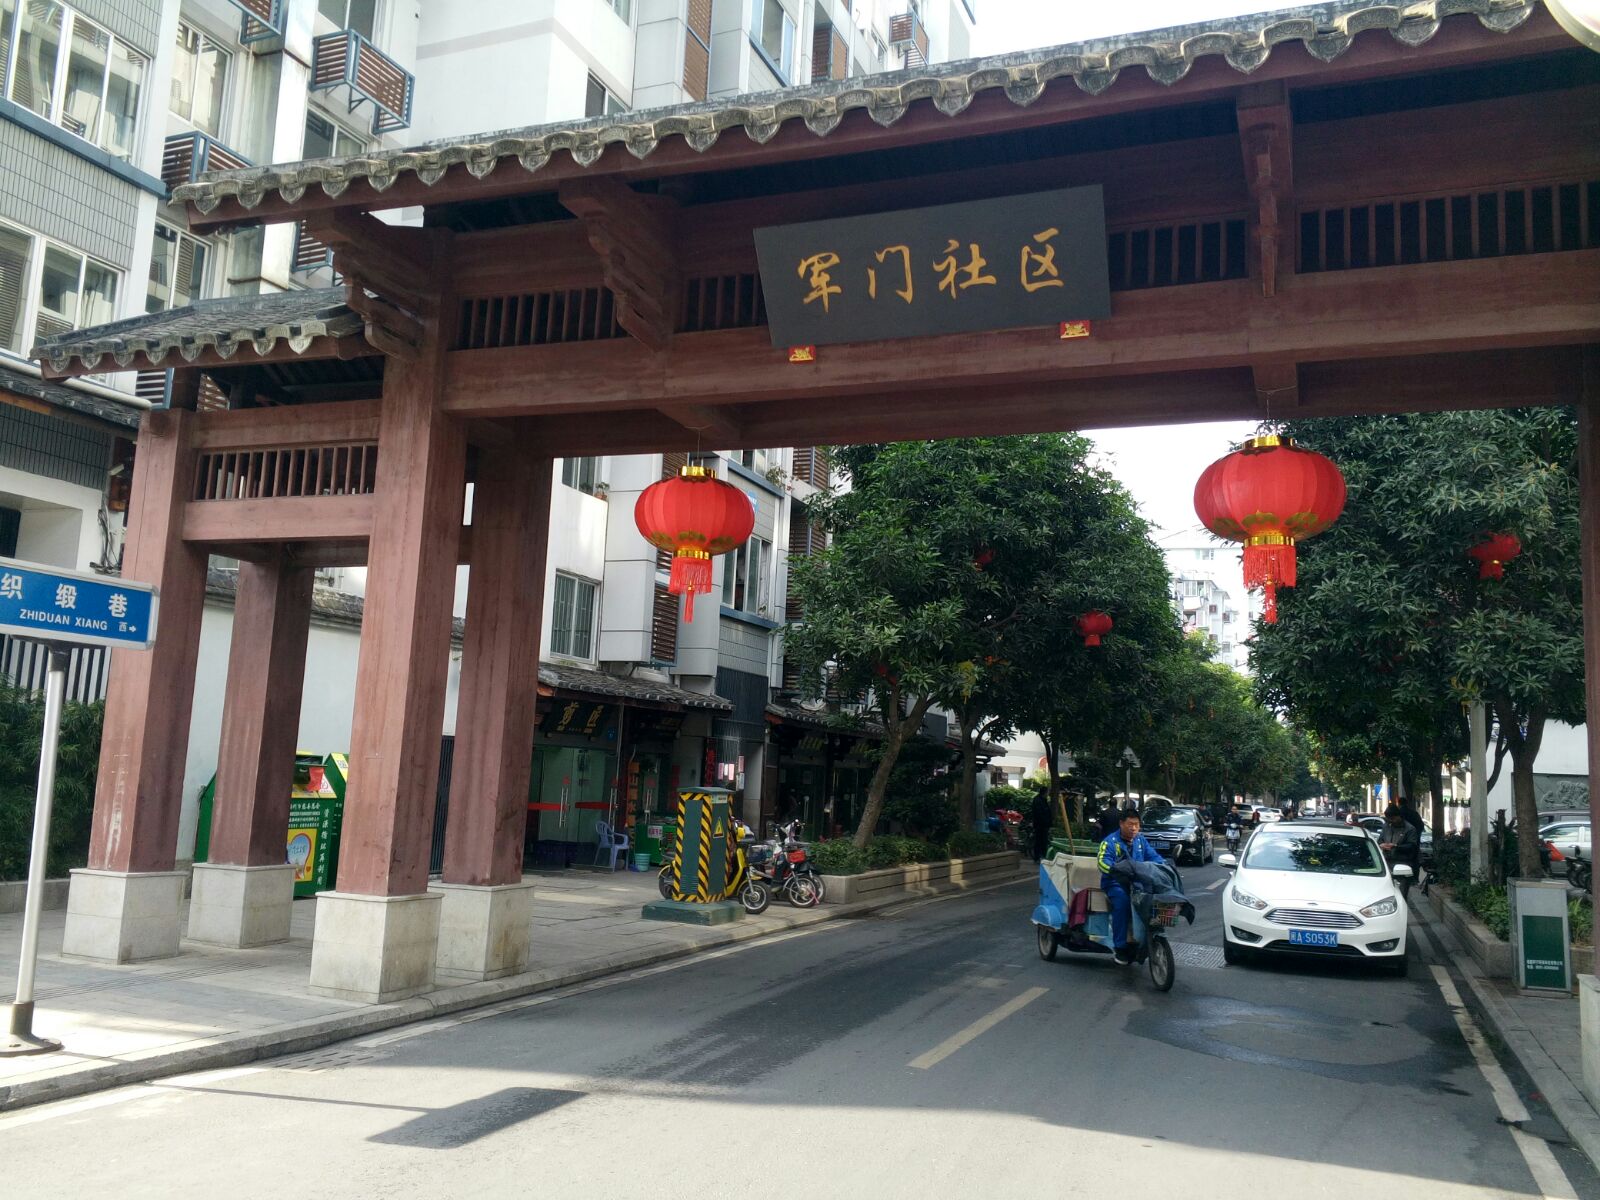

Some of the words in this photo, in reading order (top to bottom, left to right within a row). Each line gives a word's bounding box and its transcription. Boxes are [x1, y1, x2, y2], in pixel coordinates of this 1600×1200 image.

[797, 227, 1064, 313] 军门社区
[0, 572, 128, 618] 织缎巷
[19, 608, 70, 625] ZHIDUAN
[75, 617, 108, 631] XIANG
